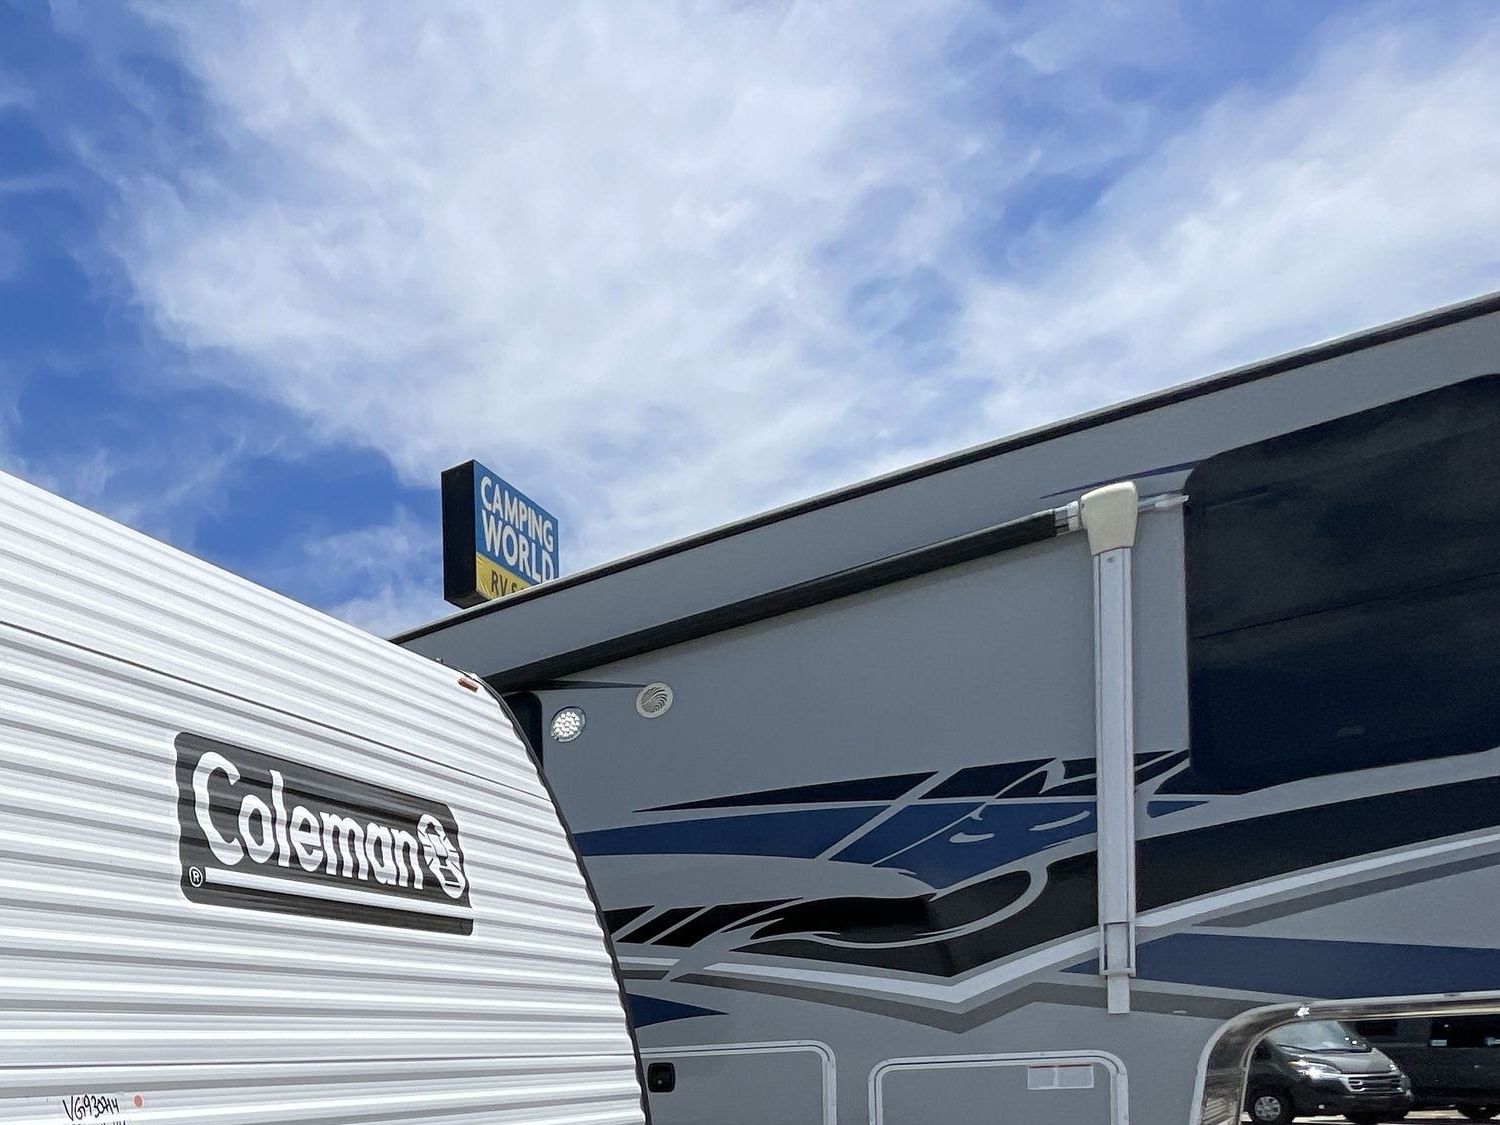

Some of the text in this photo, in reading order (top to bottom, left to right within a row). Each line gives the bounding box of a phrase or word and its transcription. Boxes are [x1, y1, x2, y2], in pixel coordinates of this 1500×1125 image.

[481, 476, 554, 553] CAMPING
[482, 509, 554, 583] WORLD
[491, 569, 508, 597] RV
[192, 751, 424, 890] Coleman
